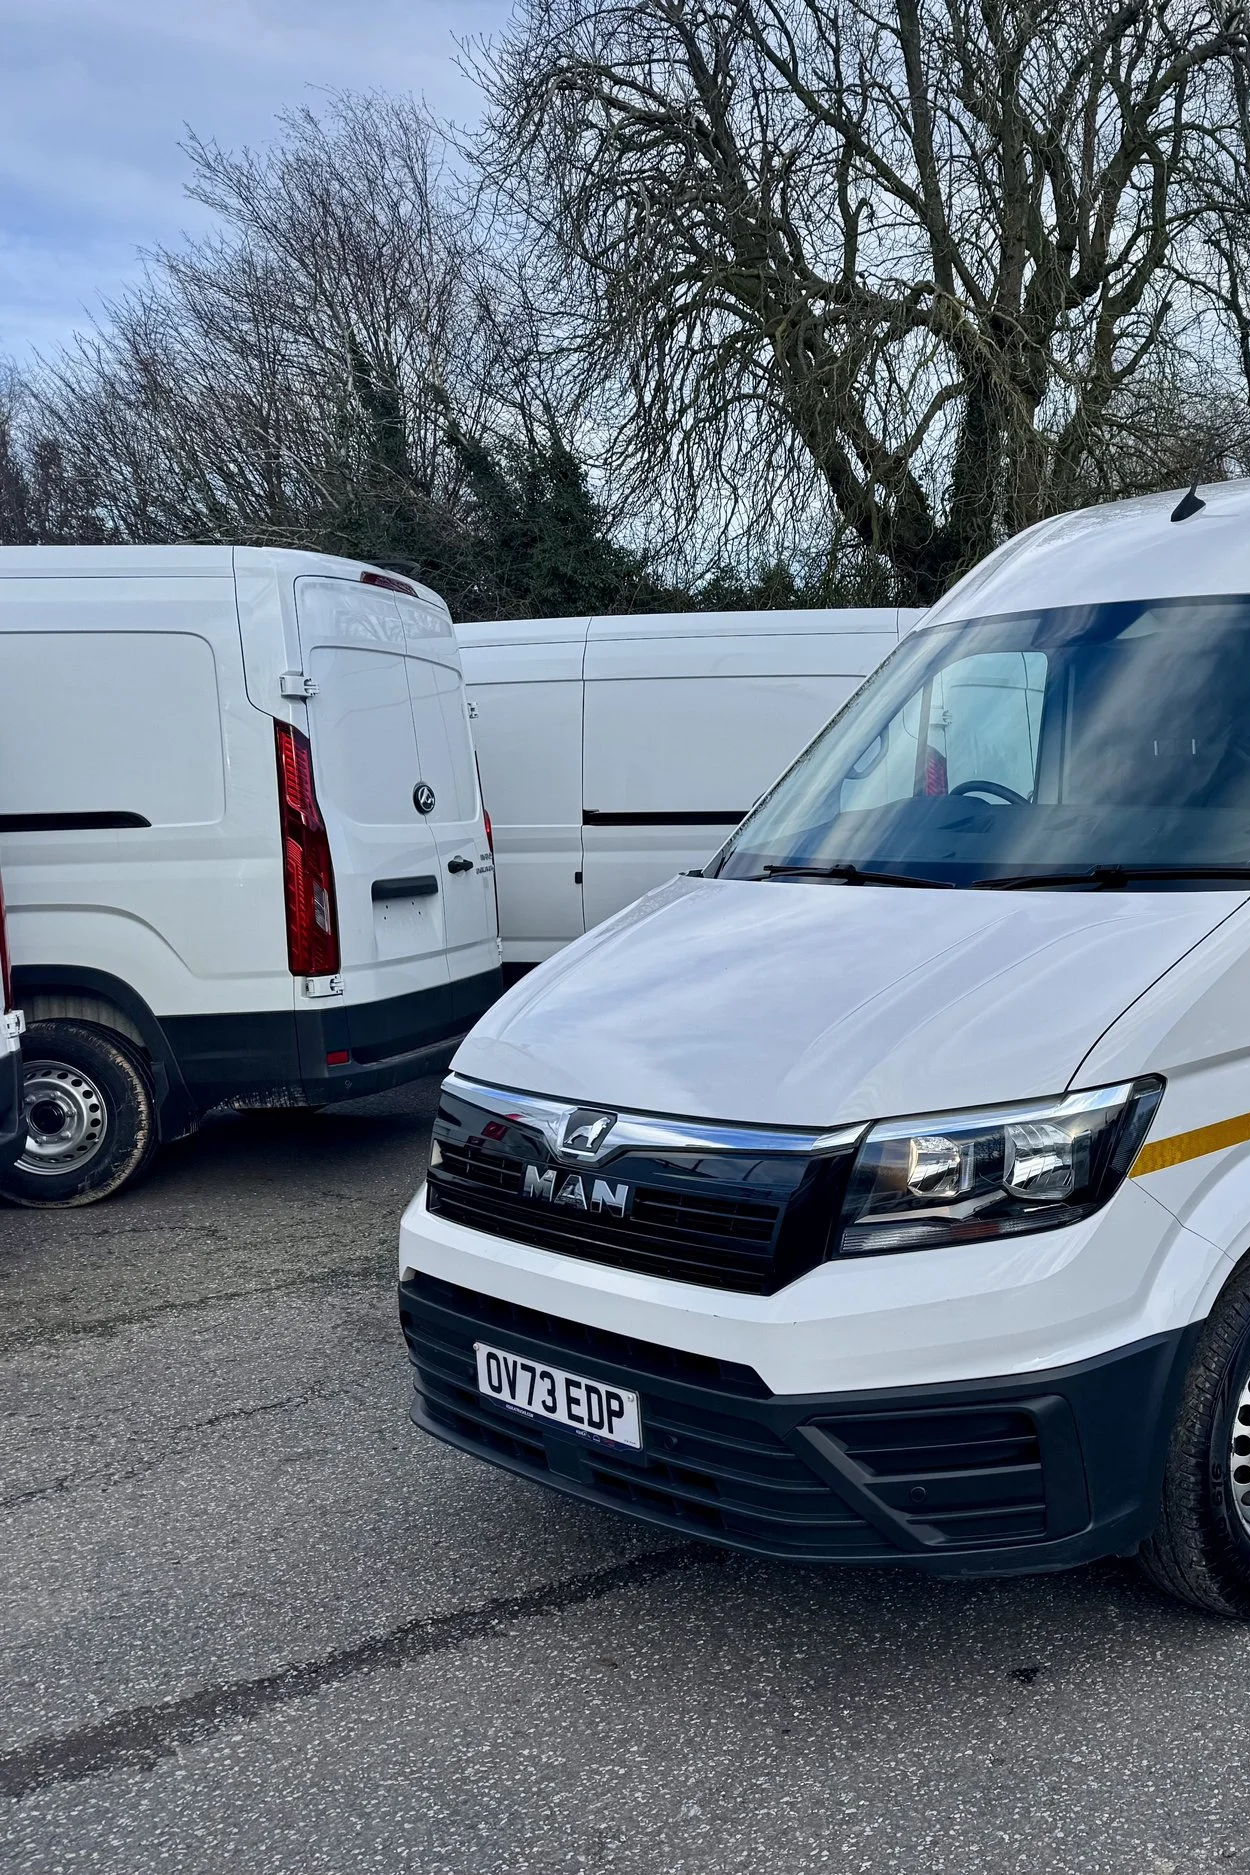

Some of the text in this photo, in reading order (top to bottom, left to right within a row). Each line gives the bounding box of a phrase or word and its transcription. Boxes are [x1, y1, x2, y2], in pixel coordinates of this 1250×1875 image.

[523, 1164, 629, 1218] MAN
[486, 1351, 625, 1435] OV73 EDP
